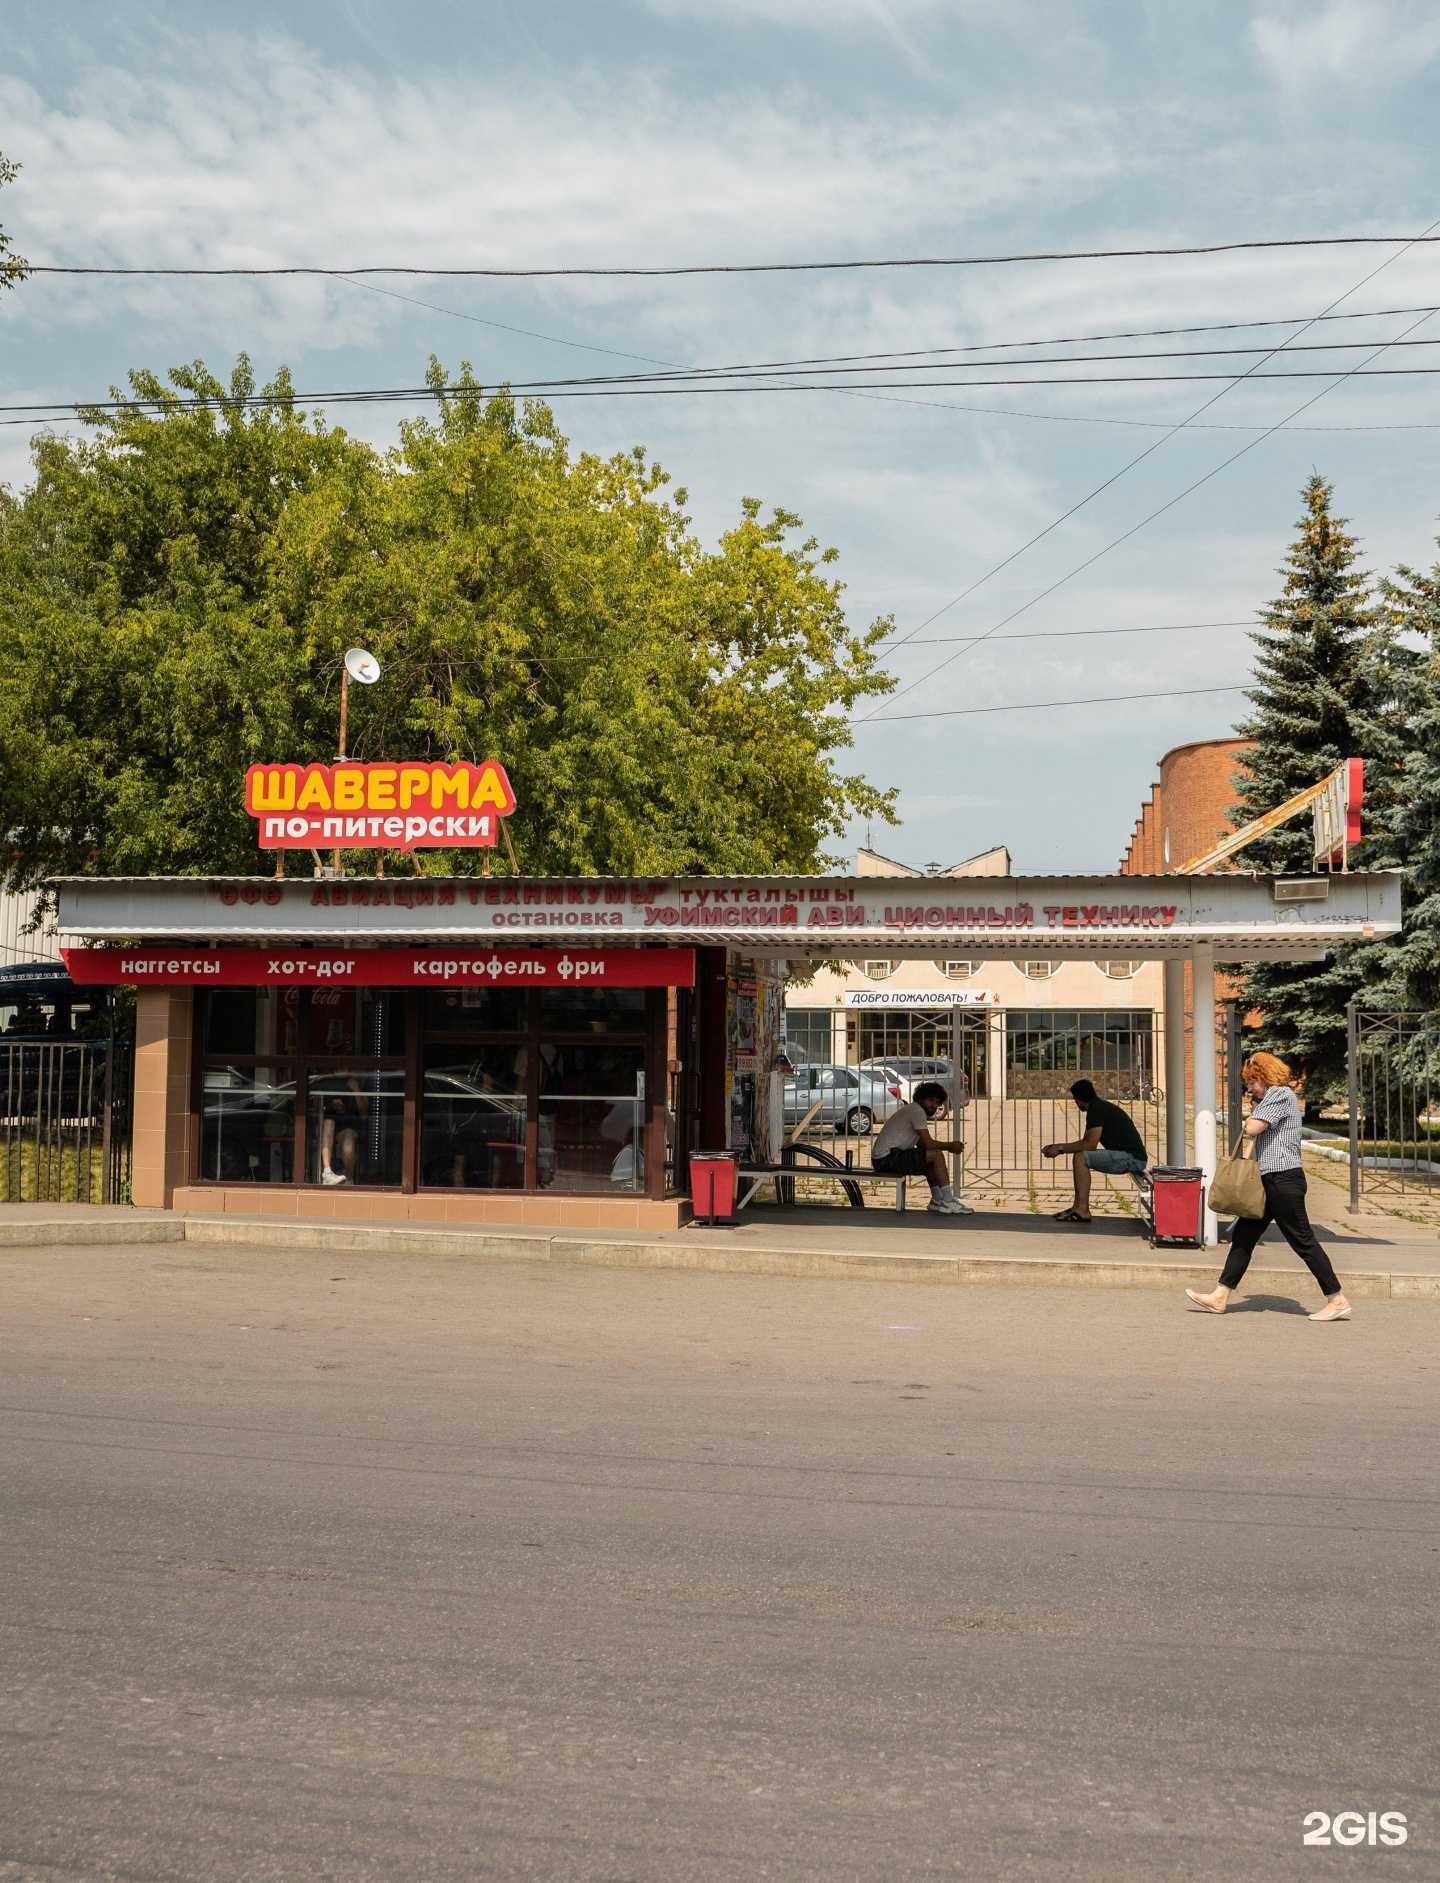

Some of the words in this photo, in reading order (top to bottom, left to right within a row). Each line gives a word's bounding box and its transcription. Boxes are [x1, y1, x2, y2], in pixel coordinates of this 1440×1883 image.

[252, 768, 508, 811] ШАВЕРМА
[265, 815, 489, 842] по-питерски
[311, 885, 456, 909] АВИАЦИЯ
[491, 911, 623, 926] остановка
[644, 904, 798, 926] УФИМСКИЙ
[1043, 905, 1177, 927] ТЕХНИКУ
[121, 959, 221, 974] наггетсы
[267, 960, 355, 977] хот-дог
[413, 955, 547, 979] картофель
[557, 955, 605, 979] фри
[852, 993, 889, 1004] ДОБРО
[891, 993, 968, 1003] ПОЖАЛОВАТЬ!
